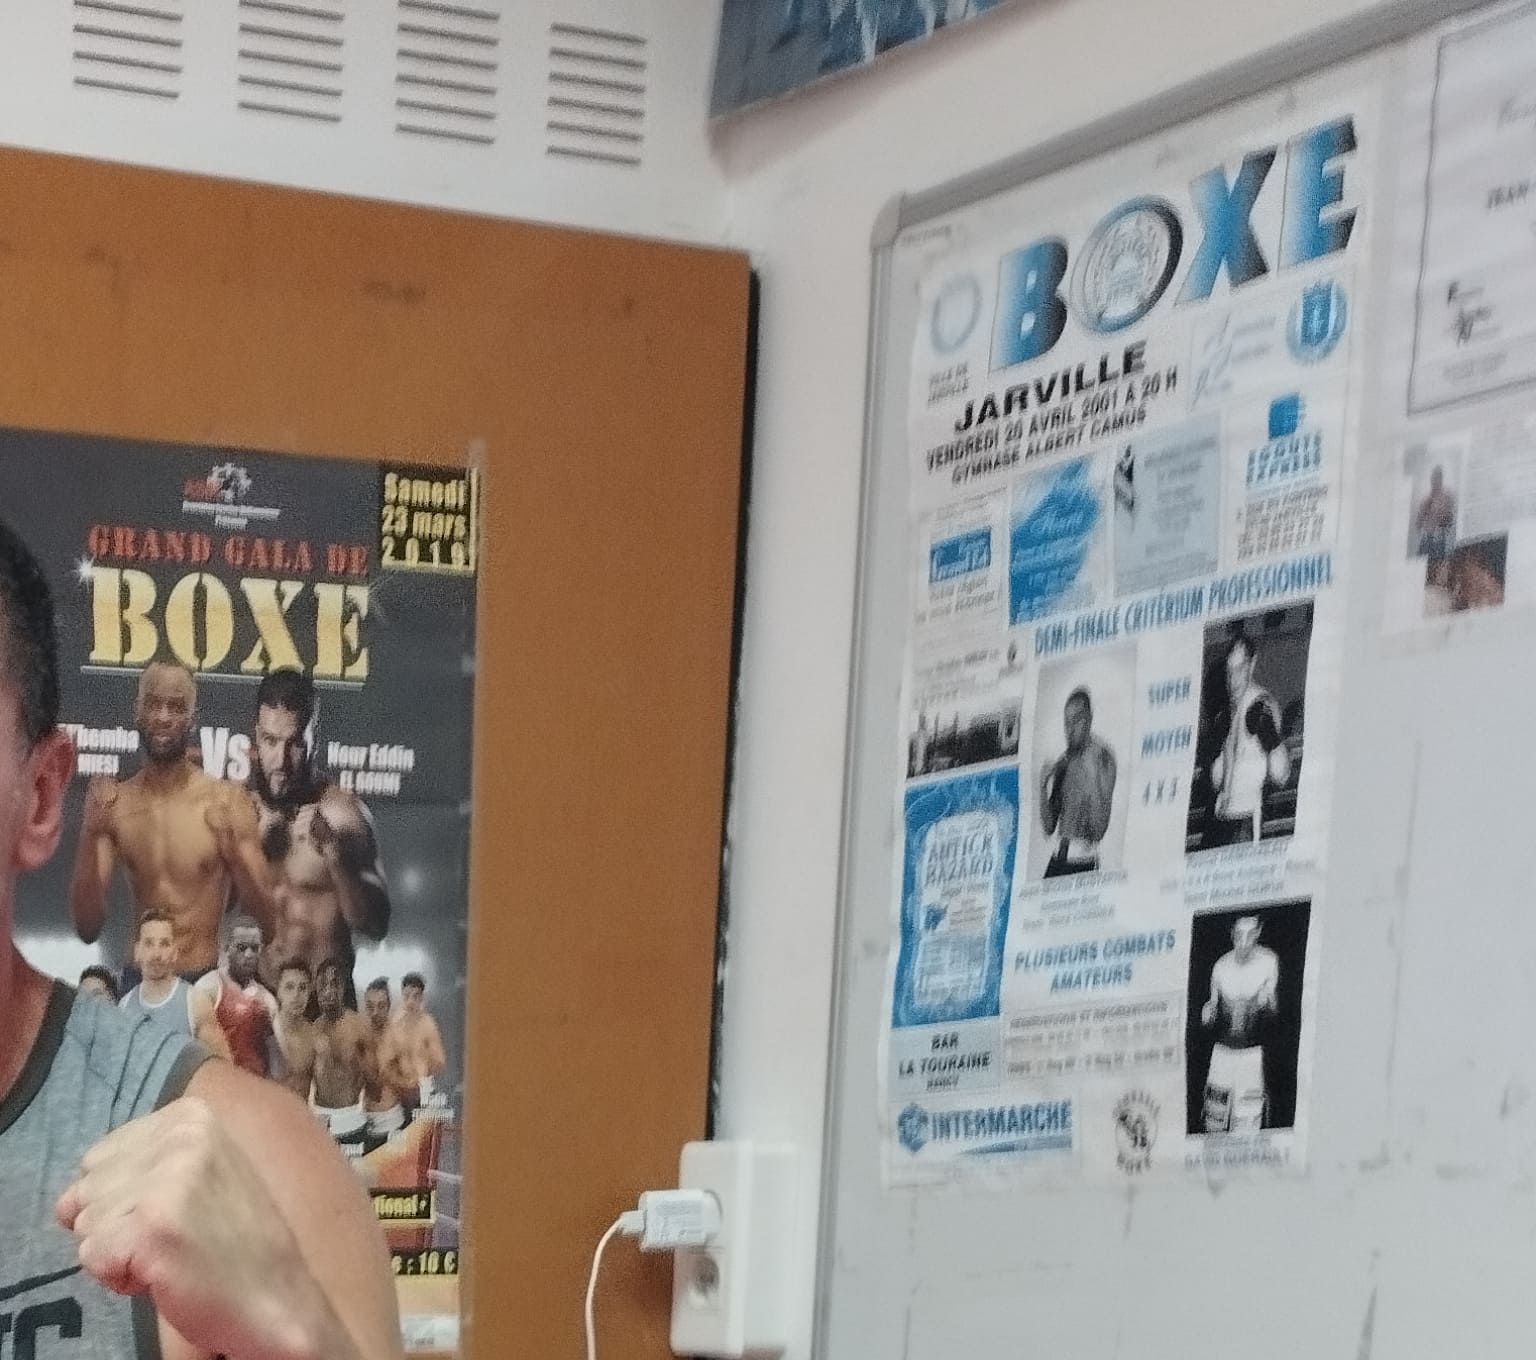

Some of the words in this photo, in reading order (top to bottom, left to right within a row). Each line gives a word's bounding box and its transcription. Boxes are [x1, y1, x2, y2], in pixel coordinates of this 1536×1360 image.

[988, 113, 1359, 373] BOXE
[954, 338, 1148, 433] JARVILLE
[927, 427, 999, 473] VENDREDI
[1028, 404, 1074, 437] AVRIL
[1166, 364, 1179, 391] H
[952, 446, 1020, 485] GYMNASE
[1025, 424, 1086, 459] ALBERT
[1090, 404, 1146, 440] CAMUS
[382, 505, 408, 536] 23
[412, 511, 465, 540] mars
[88, 524, 212, 563] GRAND
[224, 535, 312, 571] GALA
[327, 543, 368, 574] DE
[88, 565, 370, 681] BOXE
[1142, 725, 1192, 756] MOYEN
[1015, 940, 1098, 972] PLUSIEURS
[1103, 929, 1176, 958] COMBATS
[1050, 961, 1133, 995] AMATEURS
[931, 1032, 960, 1051] BAR
[898, 1058, 915, 1077] LA
[920, 1051, 992, 1074] TOURAINE
[373, 1194, 418, 1217] ional
[419, 1250, 440, 1274] 10
